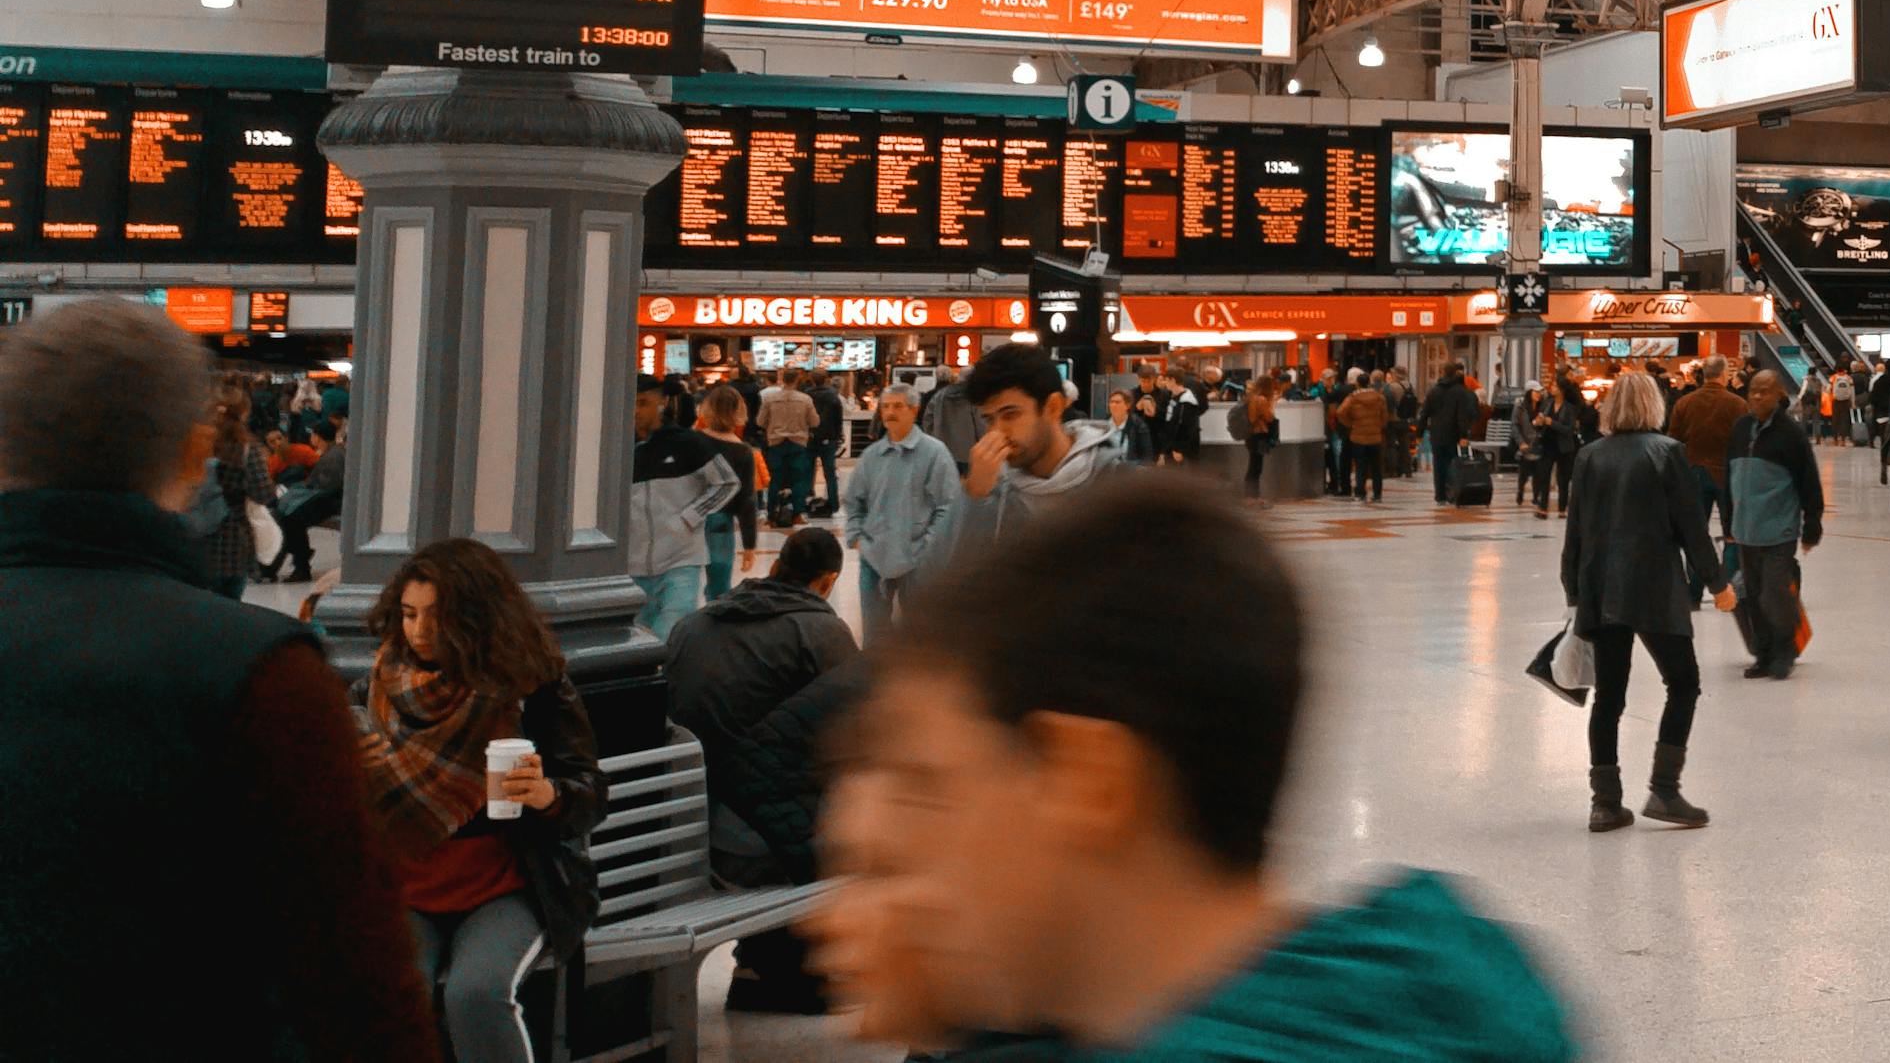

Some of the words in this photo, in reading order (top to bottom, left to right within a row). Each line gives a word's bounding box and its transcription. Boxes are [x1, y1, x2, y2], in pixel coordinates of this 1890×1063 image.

[1161, 9, 1249, 24] norwegian.com
[1812, 3, 1841, 40] GX
[579, 25, 669, 47] 13:38:00
[438, 43, 519, 64] Fastest
[526, 47, 573, 65] train
[578, 49, 601, 67] to
[1836, 249, 1889, 259] BREITLING
[694, 297, 838, 325] BURGER
[841, 299, 929, 326] KING
[1193, 301, 1239, 328] GX
[1287, 310, 1327, 320] EXPRESS
[1592, 293, 1640, 319] Upper
[1643, 295, 1692, 316] Crust
